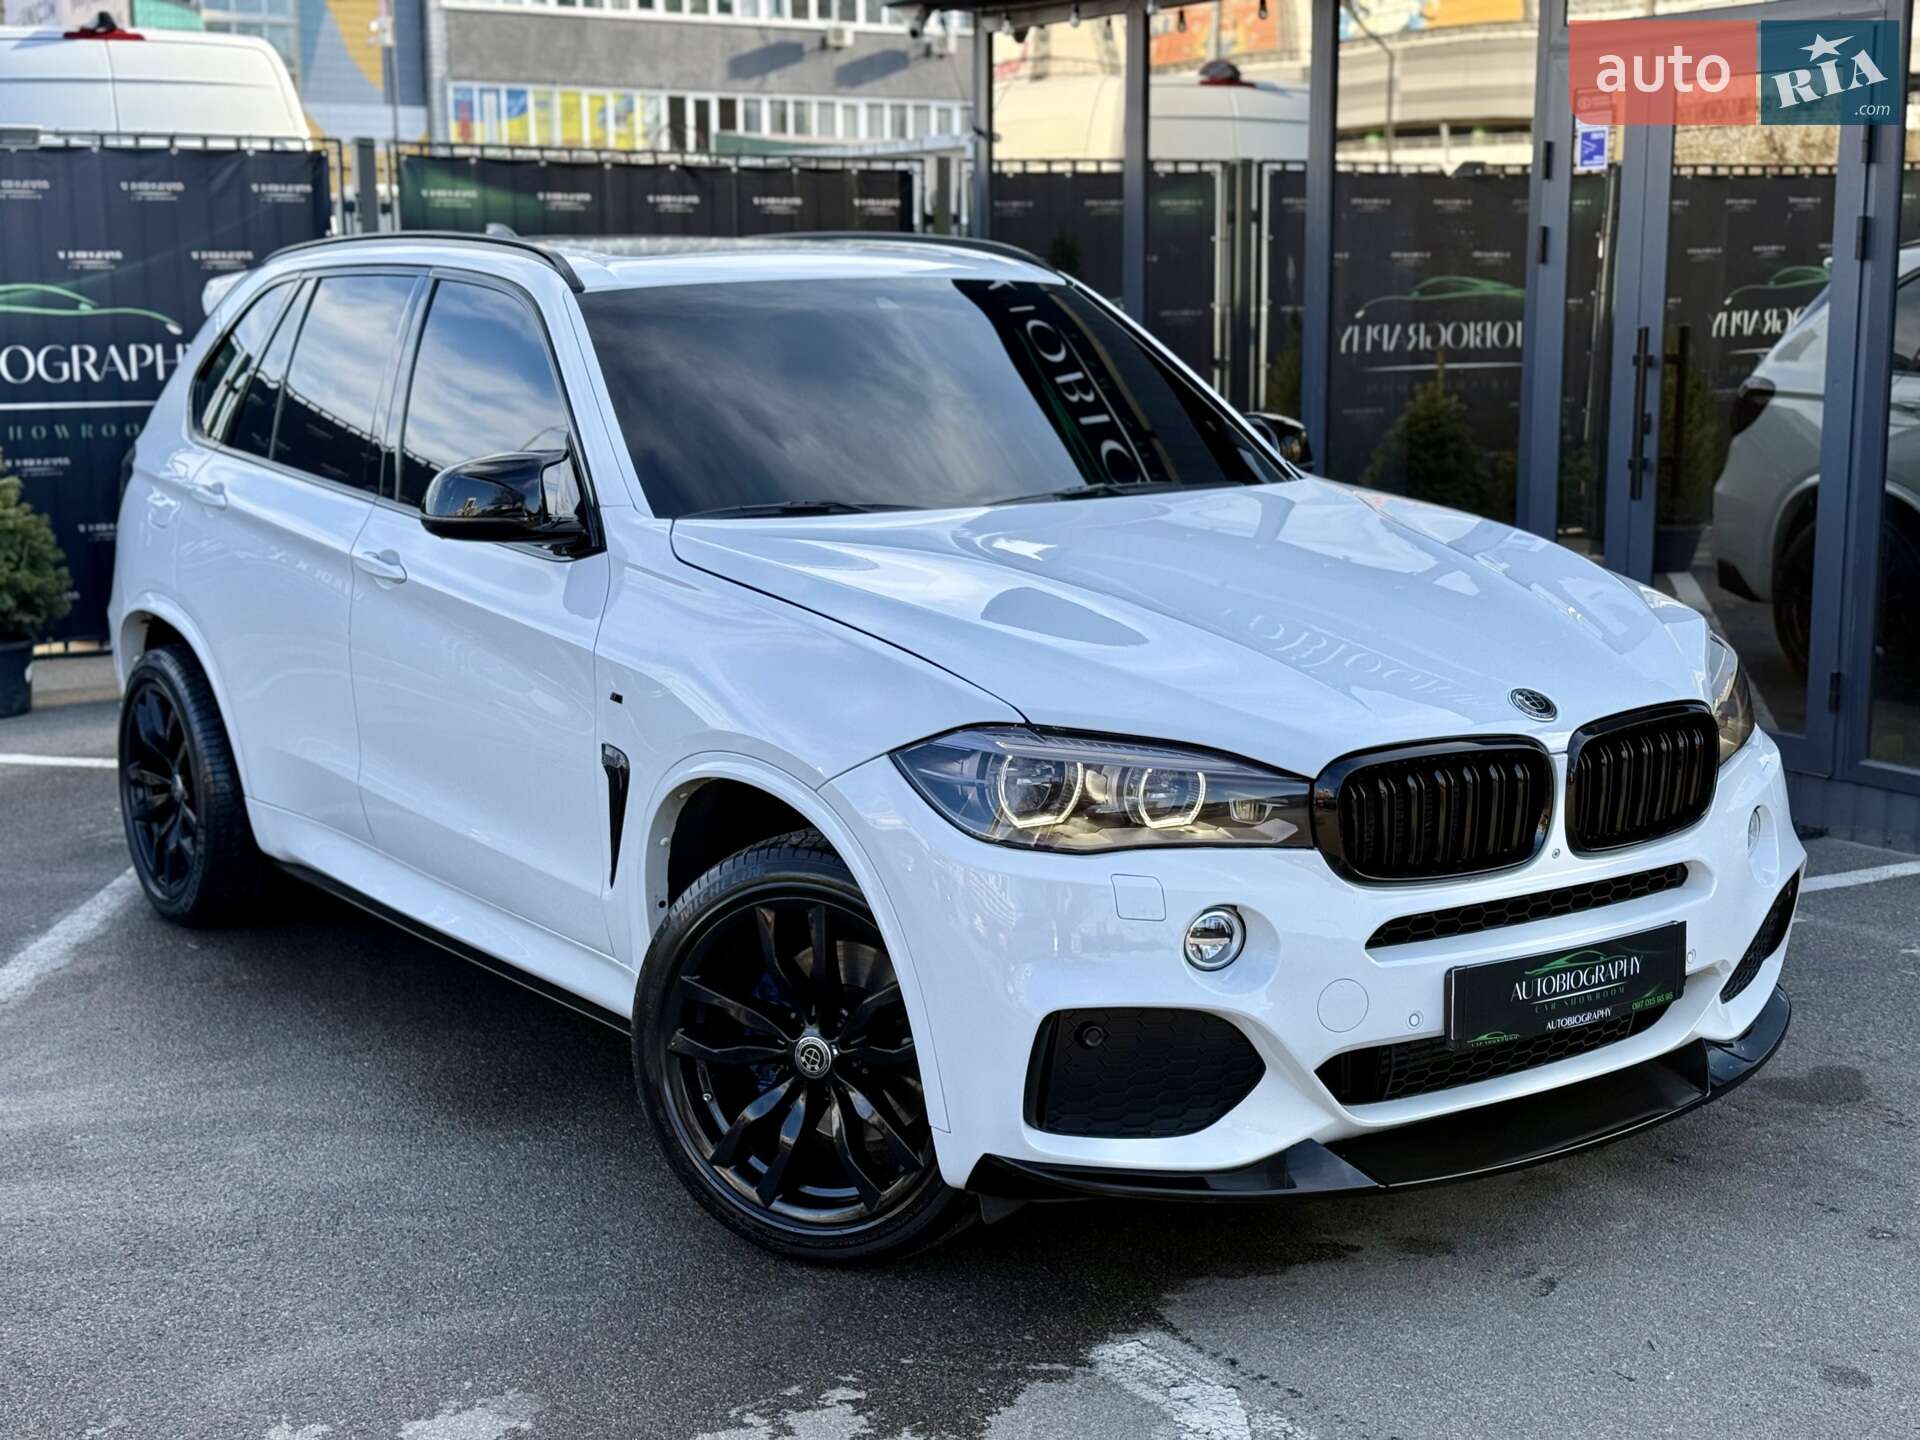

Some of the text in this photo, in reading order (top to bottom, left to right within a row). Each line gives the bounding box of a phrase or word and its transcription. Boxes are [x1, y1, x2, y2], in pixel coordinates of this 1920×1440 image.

[0, 343, 191, 384] OGRAPH
[1510, 955, 1644, 1003] AUTOBIOGRAPHY
[1546, 1007, 1613, 1031] AUTOBIOGRAPHY
